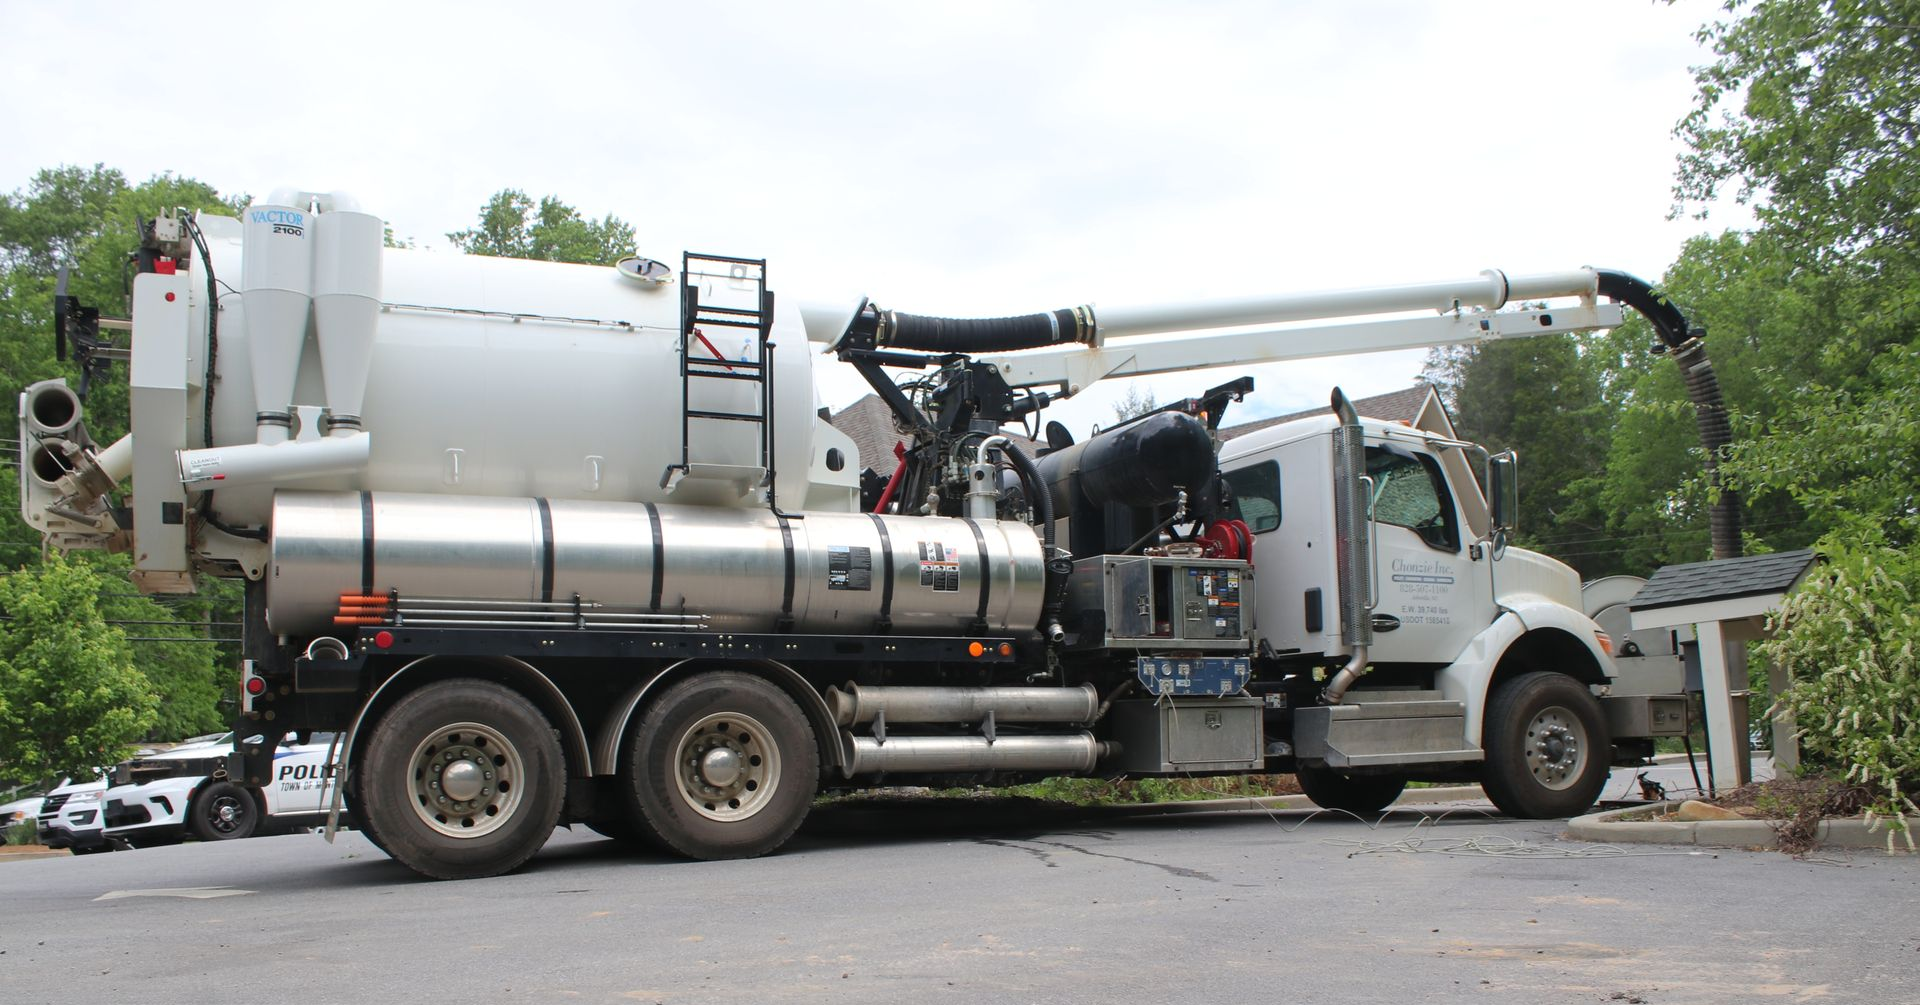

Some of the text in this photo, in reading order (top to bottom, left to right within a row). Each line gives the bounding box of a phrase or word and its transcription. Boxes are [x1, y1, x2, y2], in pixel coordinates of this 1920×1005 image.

[251, 211, 304, 226] VACTOR
[273, 226, 302, 237] 2100
[1392, 559, 1454, 574] Chonzie Inc.
[1400, 616, 1424, 624] USDOT
[281, 782, 301, 792] TOWN
[303, 781, 313, 790] OF
